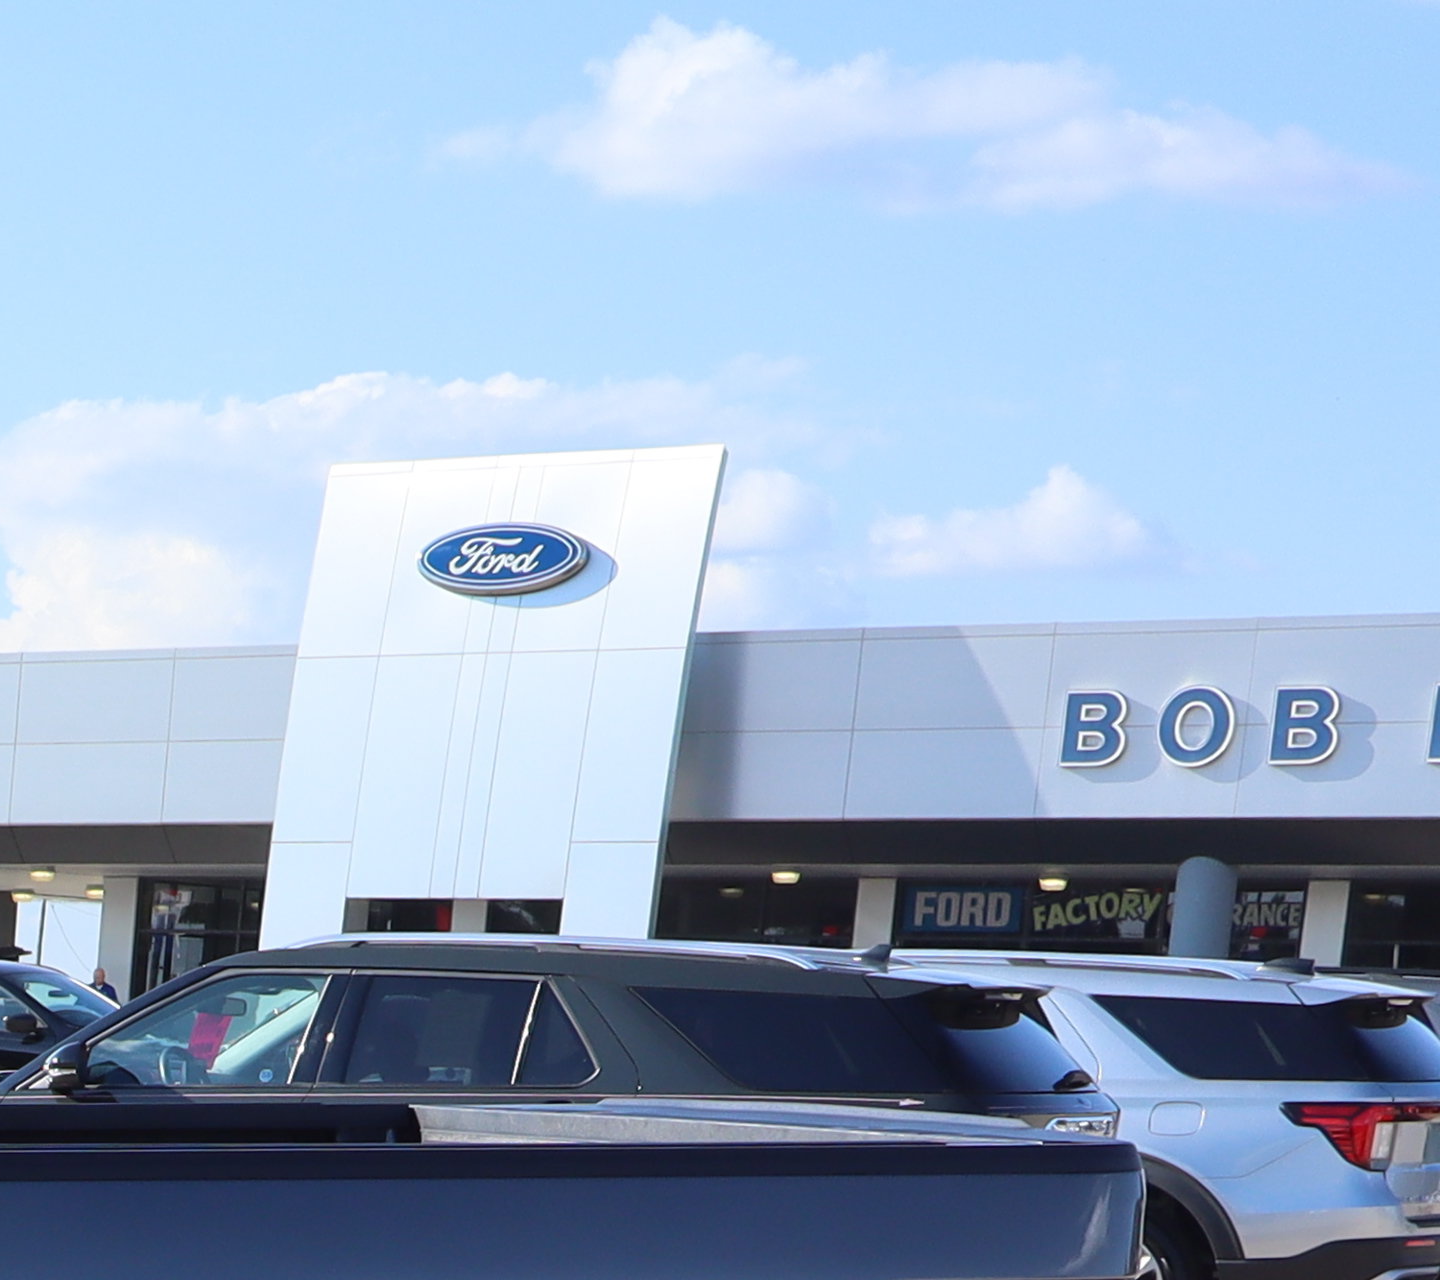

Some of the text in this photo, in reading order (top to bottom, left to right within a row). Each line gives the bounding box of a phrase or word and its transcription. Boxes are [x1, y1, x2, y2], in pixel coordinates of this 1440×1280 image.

[448, 537, 544, 575] Ford
[1059, 684, 1340, 768] BOB
[913, 891, 1302, 931] FORD FACTORY RANCE
